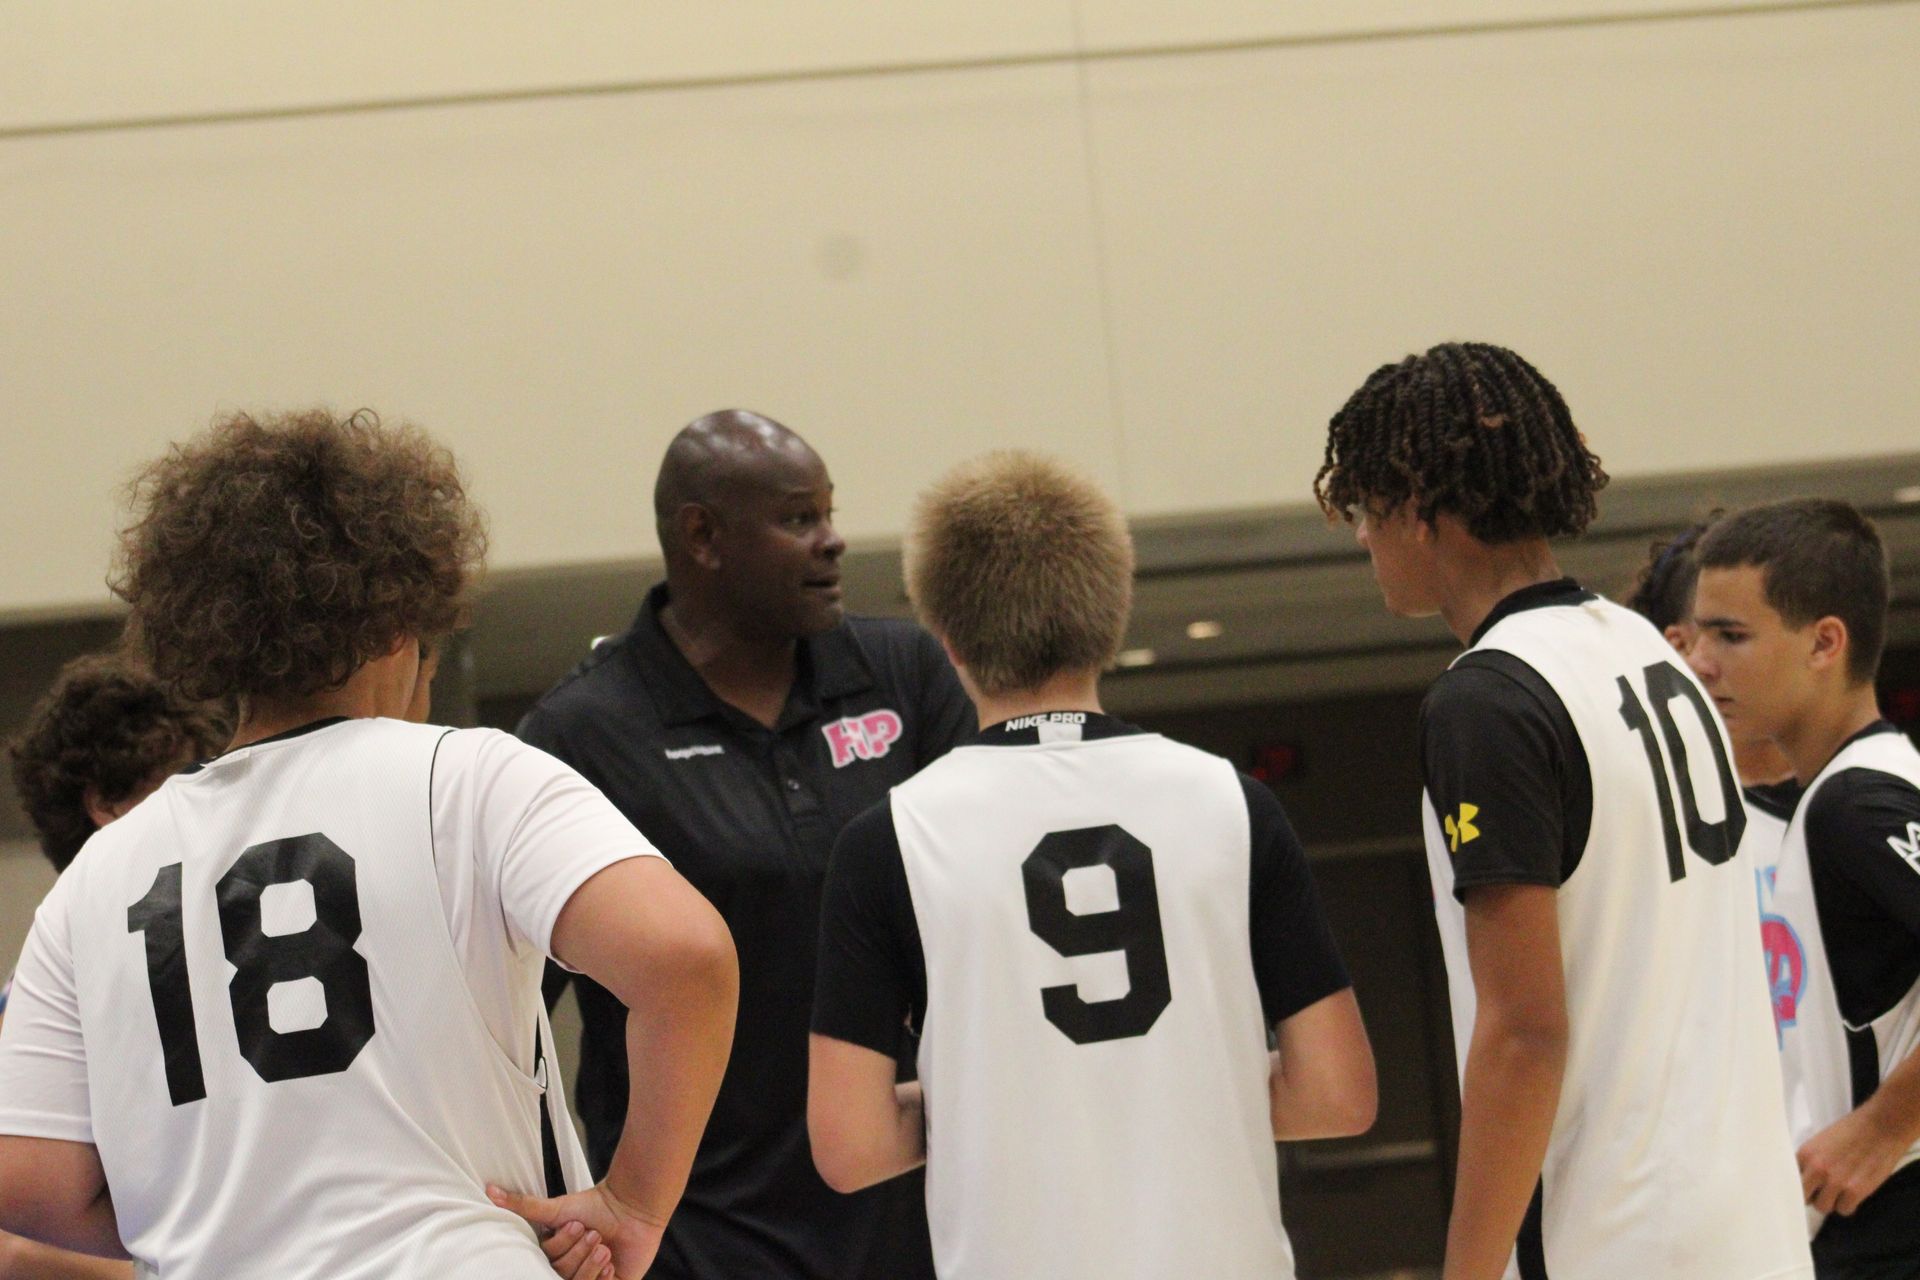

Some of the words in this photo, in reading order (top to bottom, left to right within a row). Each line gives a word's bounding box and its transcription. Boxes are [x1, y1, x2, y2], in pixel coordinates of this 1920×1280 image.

[1005, 713, 1048, 732] NIKE
[1049, 712, 1086, 724] PRO
[1615, 660, 1747, 883] 10
[127, 832, 376, 1107] 18
[1021, 823, 1172, 1045] 9
